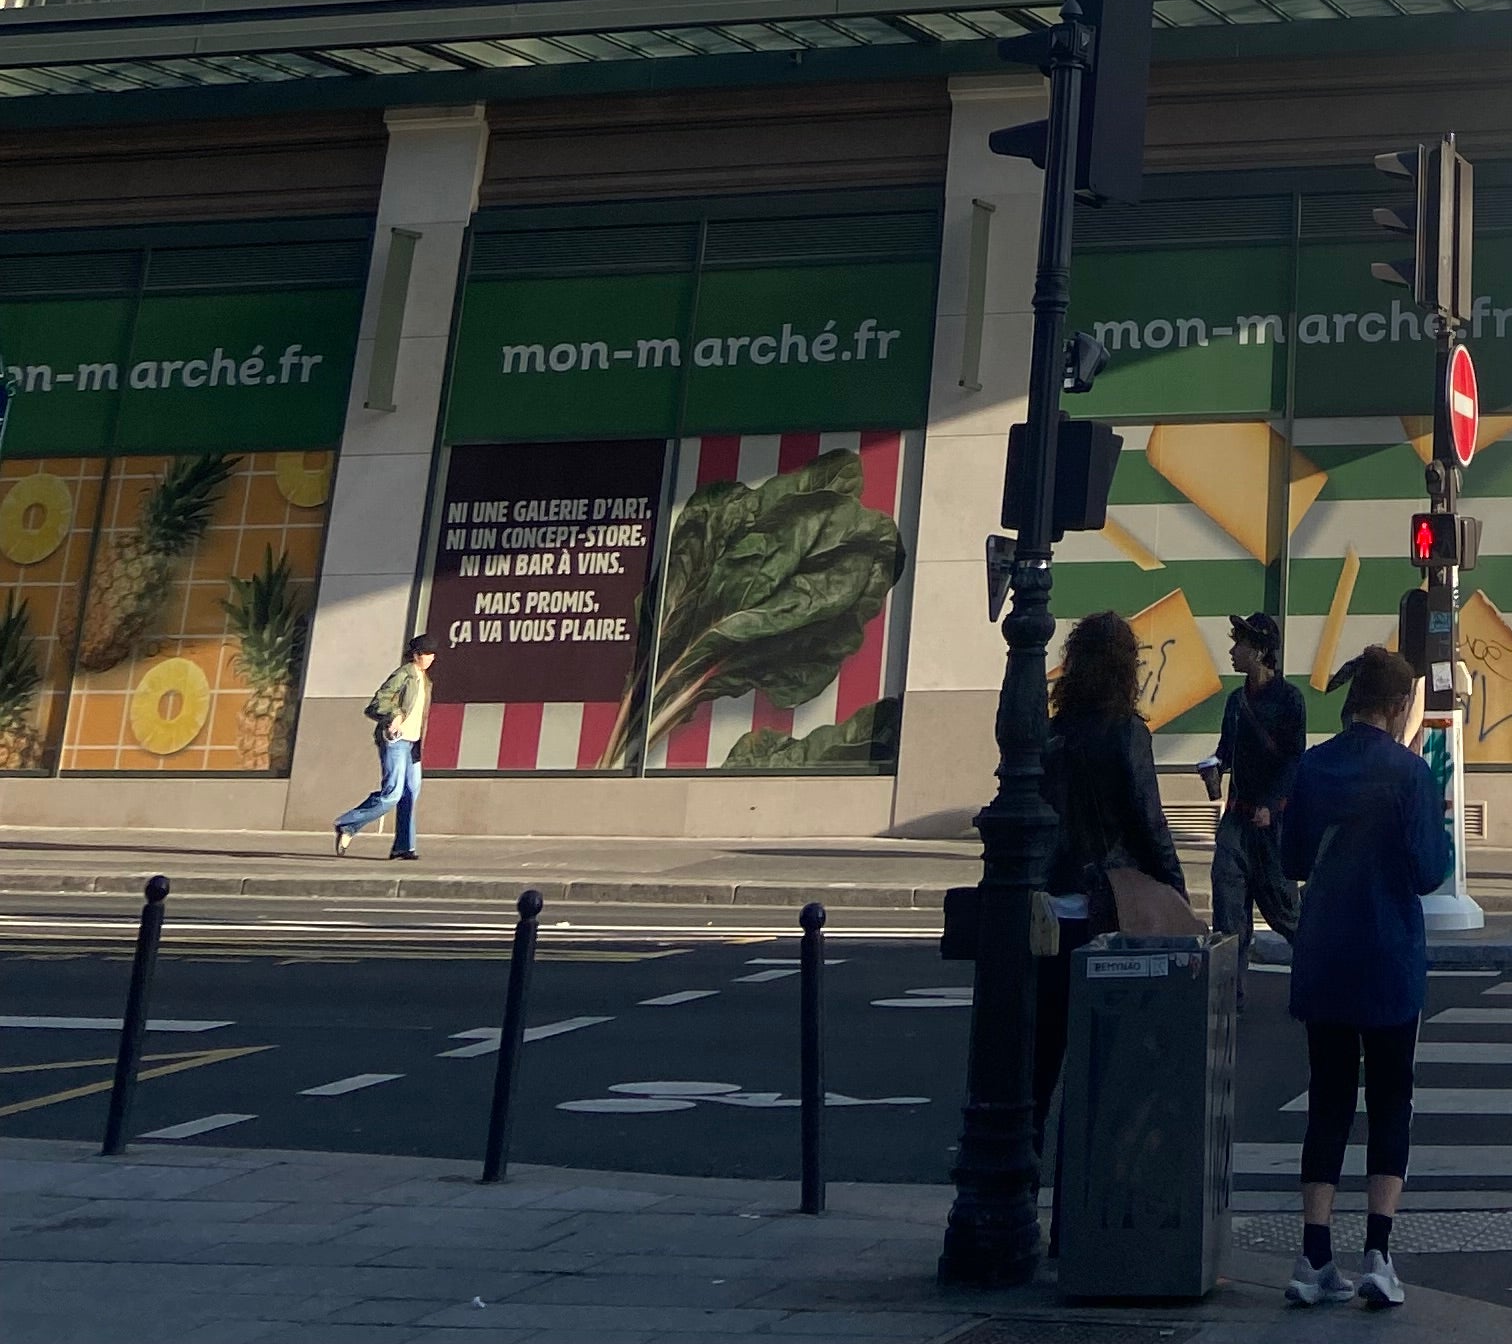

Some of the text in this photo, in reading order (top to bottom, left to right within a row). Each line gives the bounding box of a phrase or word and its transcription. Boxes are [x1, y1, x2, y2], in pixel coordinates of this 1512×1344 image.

[447, 501, 466, 523] NI
[472, 500, 509, 523] UNE
[513, 498, 588, 522] GALERIE
[446, 524, 647, 550] NI UN CONCEPT-STORE,
[459, 548, 625, 577] NI UN BAR À VINS.
[475, 590, 600, 614] MAIS PROMIS,
[449, 618, 631, 649] ÇA VA VOUS PLAIRE.
